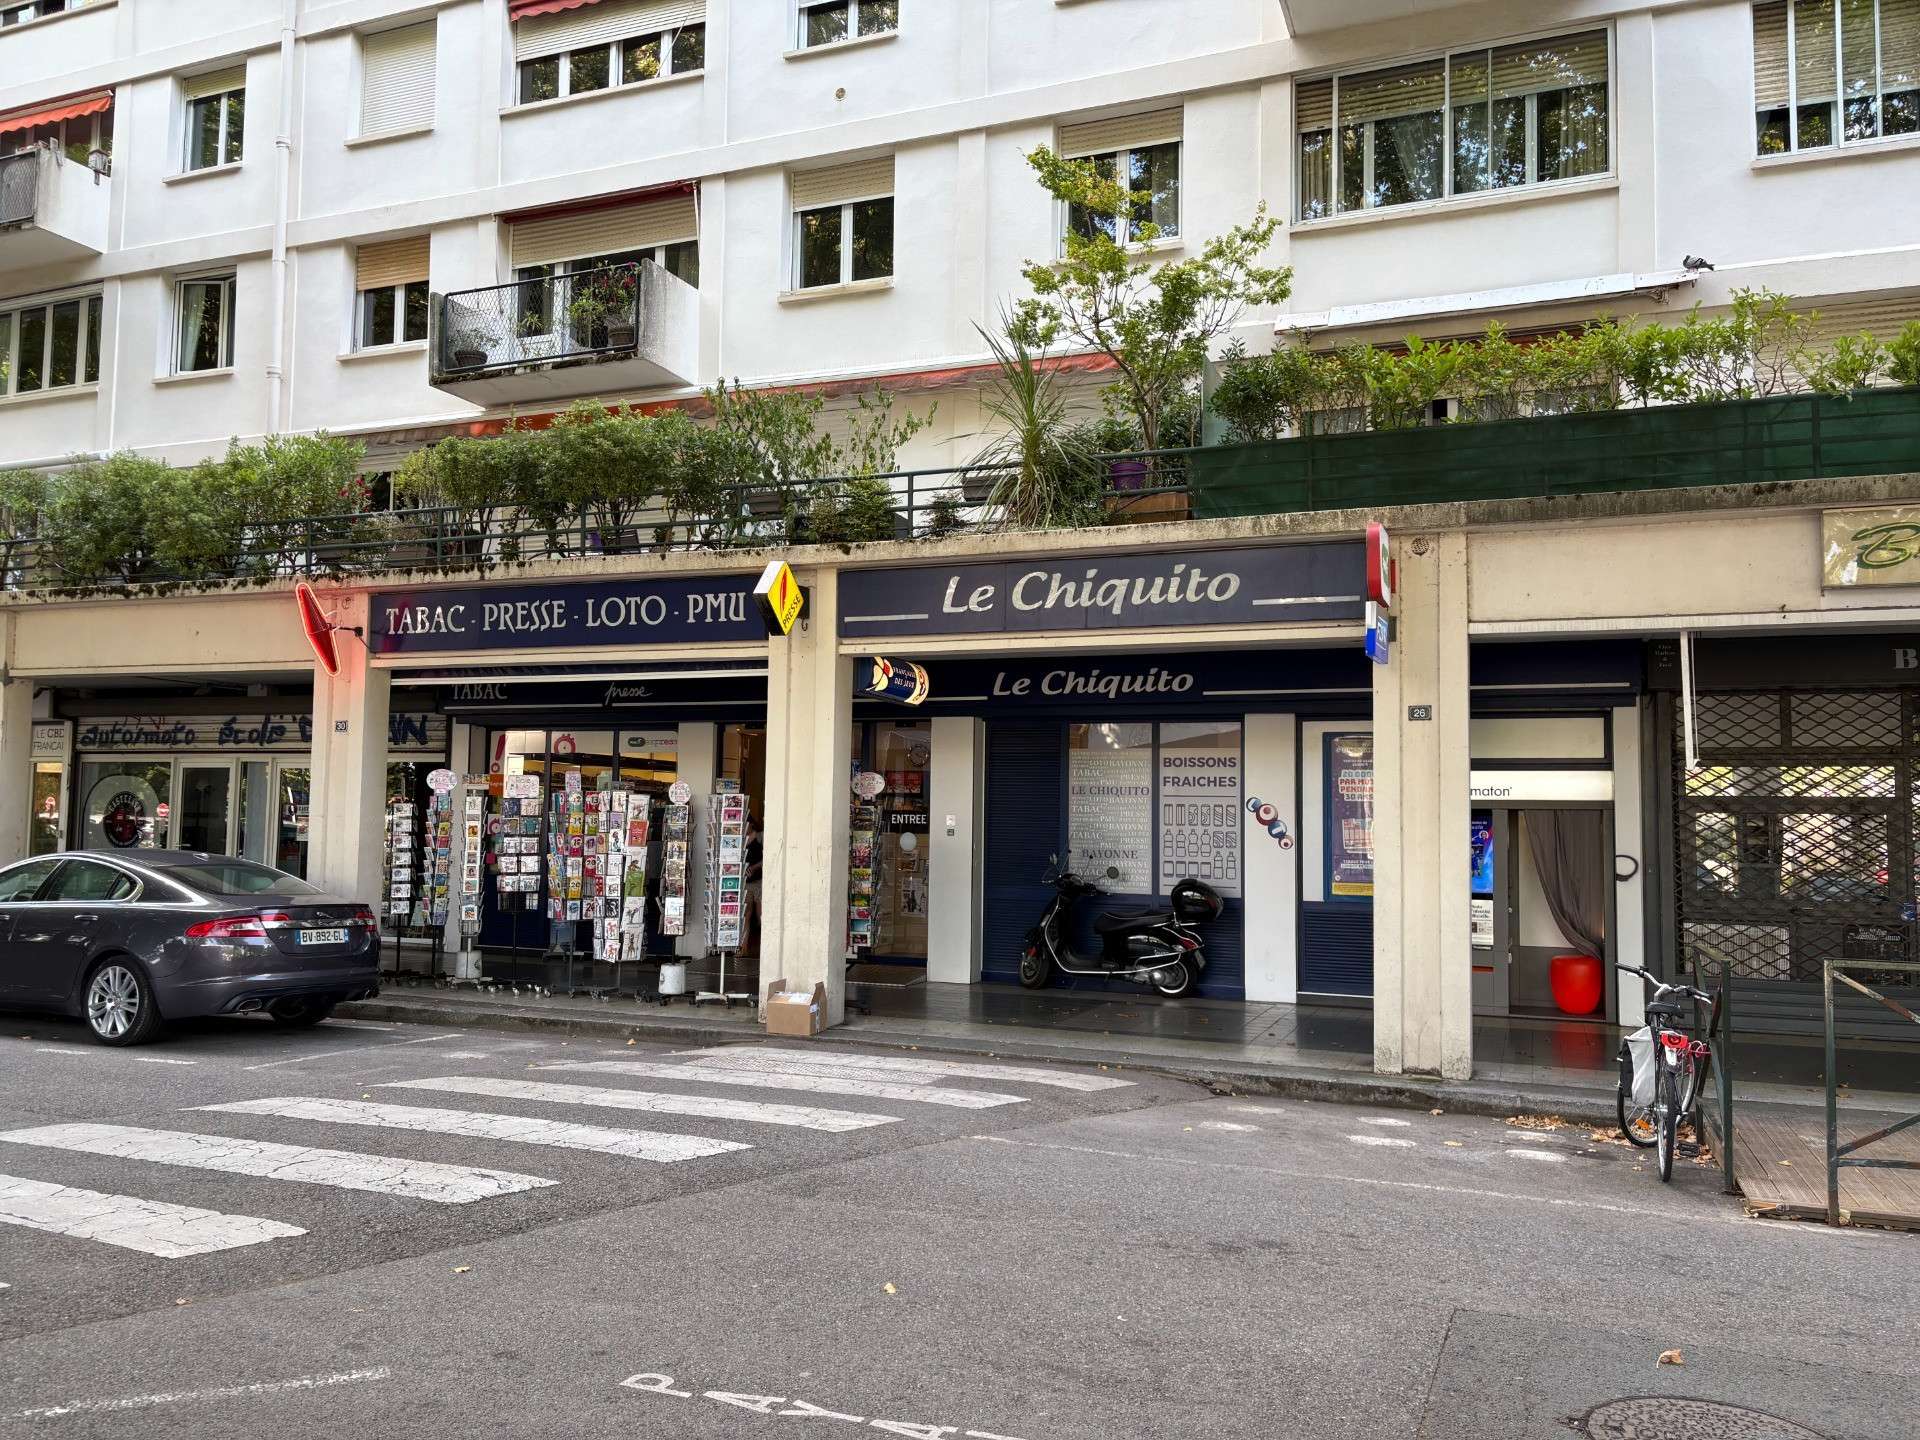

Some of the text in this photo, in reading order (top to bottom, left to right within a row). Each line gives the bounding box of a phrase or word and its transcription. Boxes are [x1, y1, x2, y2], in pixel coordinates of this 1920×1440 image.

[943, 564, 1241, 615] Le Chiquito
[386, 592, 746, 635] TABAC PRESSE LOTO PMU
[782, 594, 801, 629] PRESSE
[993, 668, 1194, 698] Le Chiquito
[451, 684, 507, 700] TABAC
[605, 683, 653, 705] presse
[1413, 708, 1426, 718] 26
[1163, 757, 1237, 768] BOISSONS
[1163, 776, 1237, 788] FRAICHES
[1072, 786, 1150, 797] LE CHIQUITO
[891, 814, 927, 824] ENTREE
[1082, 849, 1138, 859] BAYONNE
[302, 931, 343, 942] BV-892-GL
